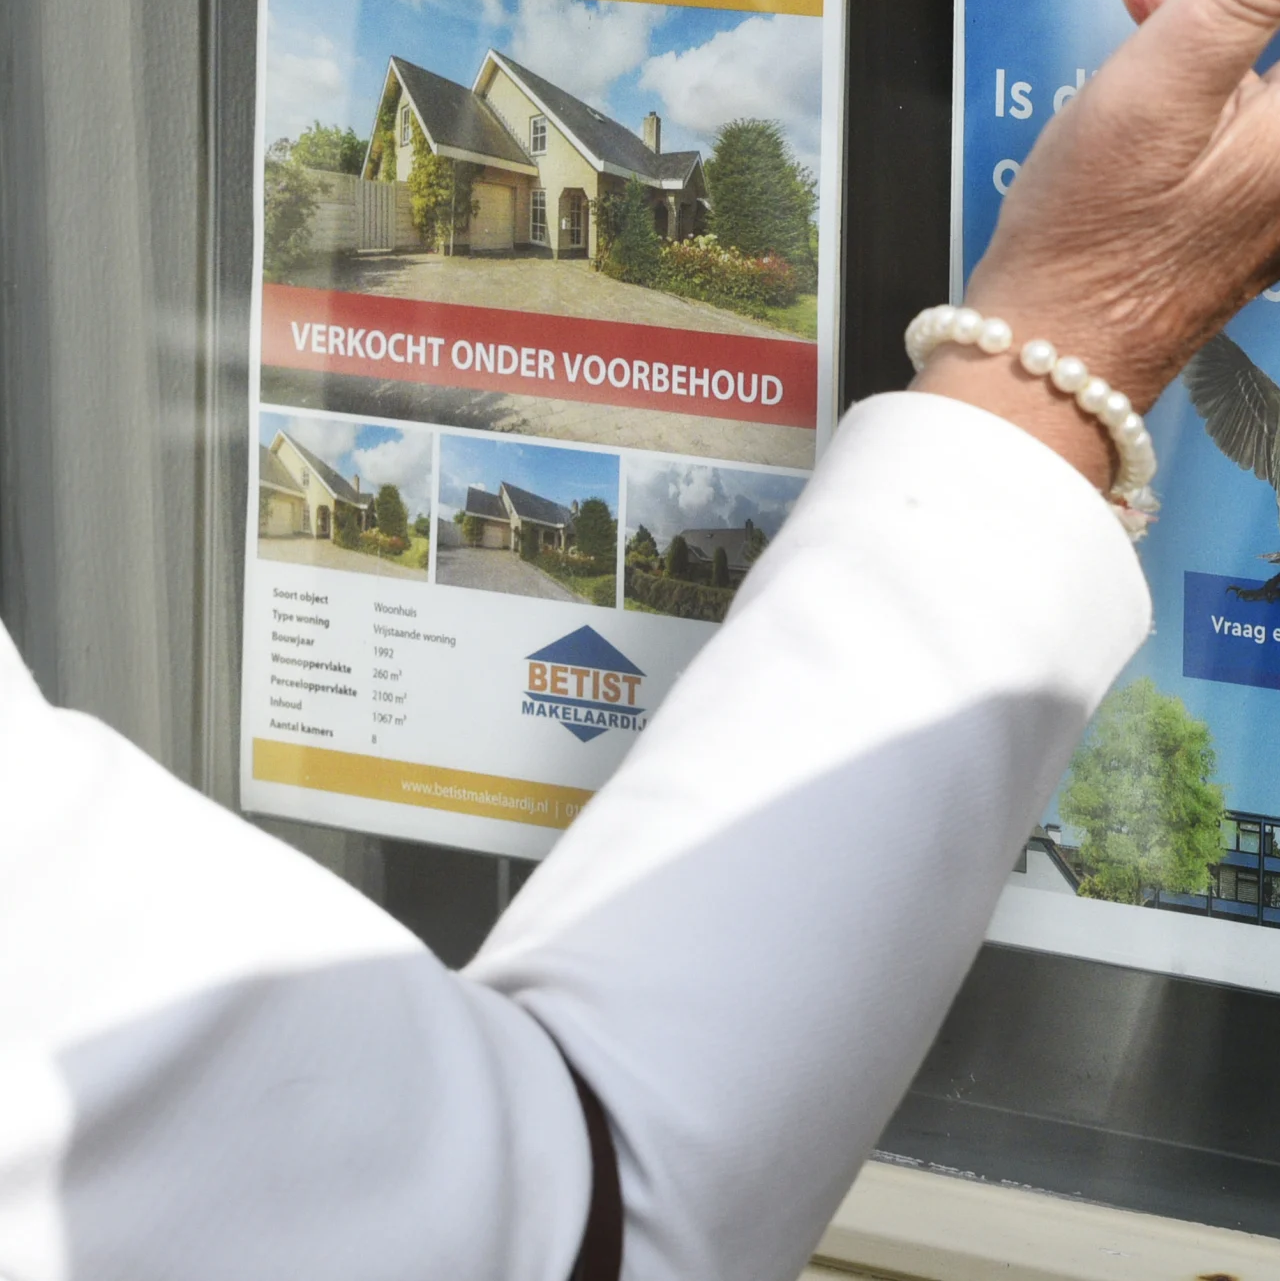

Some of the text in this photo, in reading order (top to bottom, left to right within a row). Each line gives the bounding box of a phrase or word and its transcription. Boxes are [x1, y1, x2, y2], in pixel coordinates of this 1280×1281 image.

[996, 69, 1032, 119] Is
[291, 322, 784, 406] VERKOCHT ONDER VOORBEHOUD
[273, 588, 328, 604] Soort object
[273, 610, 329, 629] Type woning
[374, 602, 417, 617] Woonhuis
[272, 632, 314, 646] Bouwjaar
[374, 624, 456, 647] Vrijstaande woning
[1211, 616, 1266, 644] Vraag
[374, 647, 394, 658] 1992
[271, 653, 352, 674] Woonoppervlakte
[271, 675, 357, 697] Perceeloppervlakte
[529, 662, 641, 705] BETIST
[270, 697, 302, 710] Inhoud
[522, 700, 647, 731] MAKELAARDIJ
[270, 719, 333, 737] Aantal kamers
[401, 779, 549, 814] www.betistmakelaardij.nl
